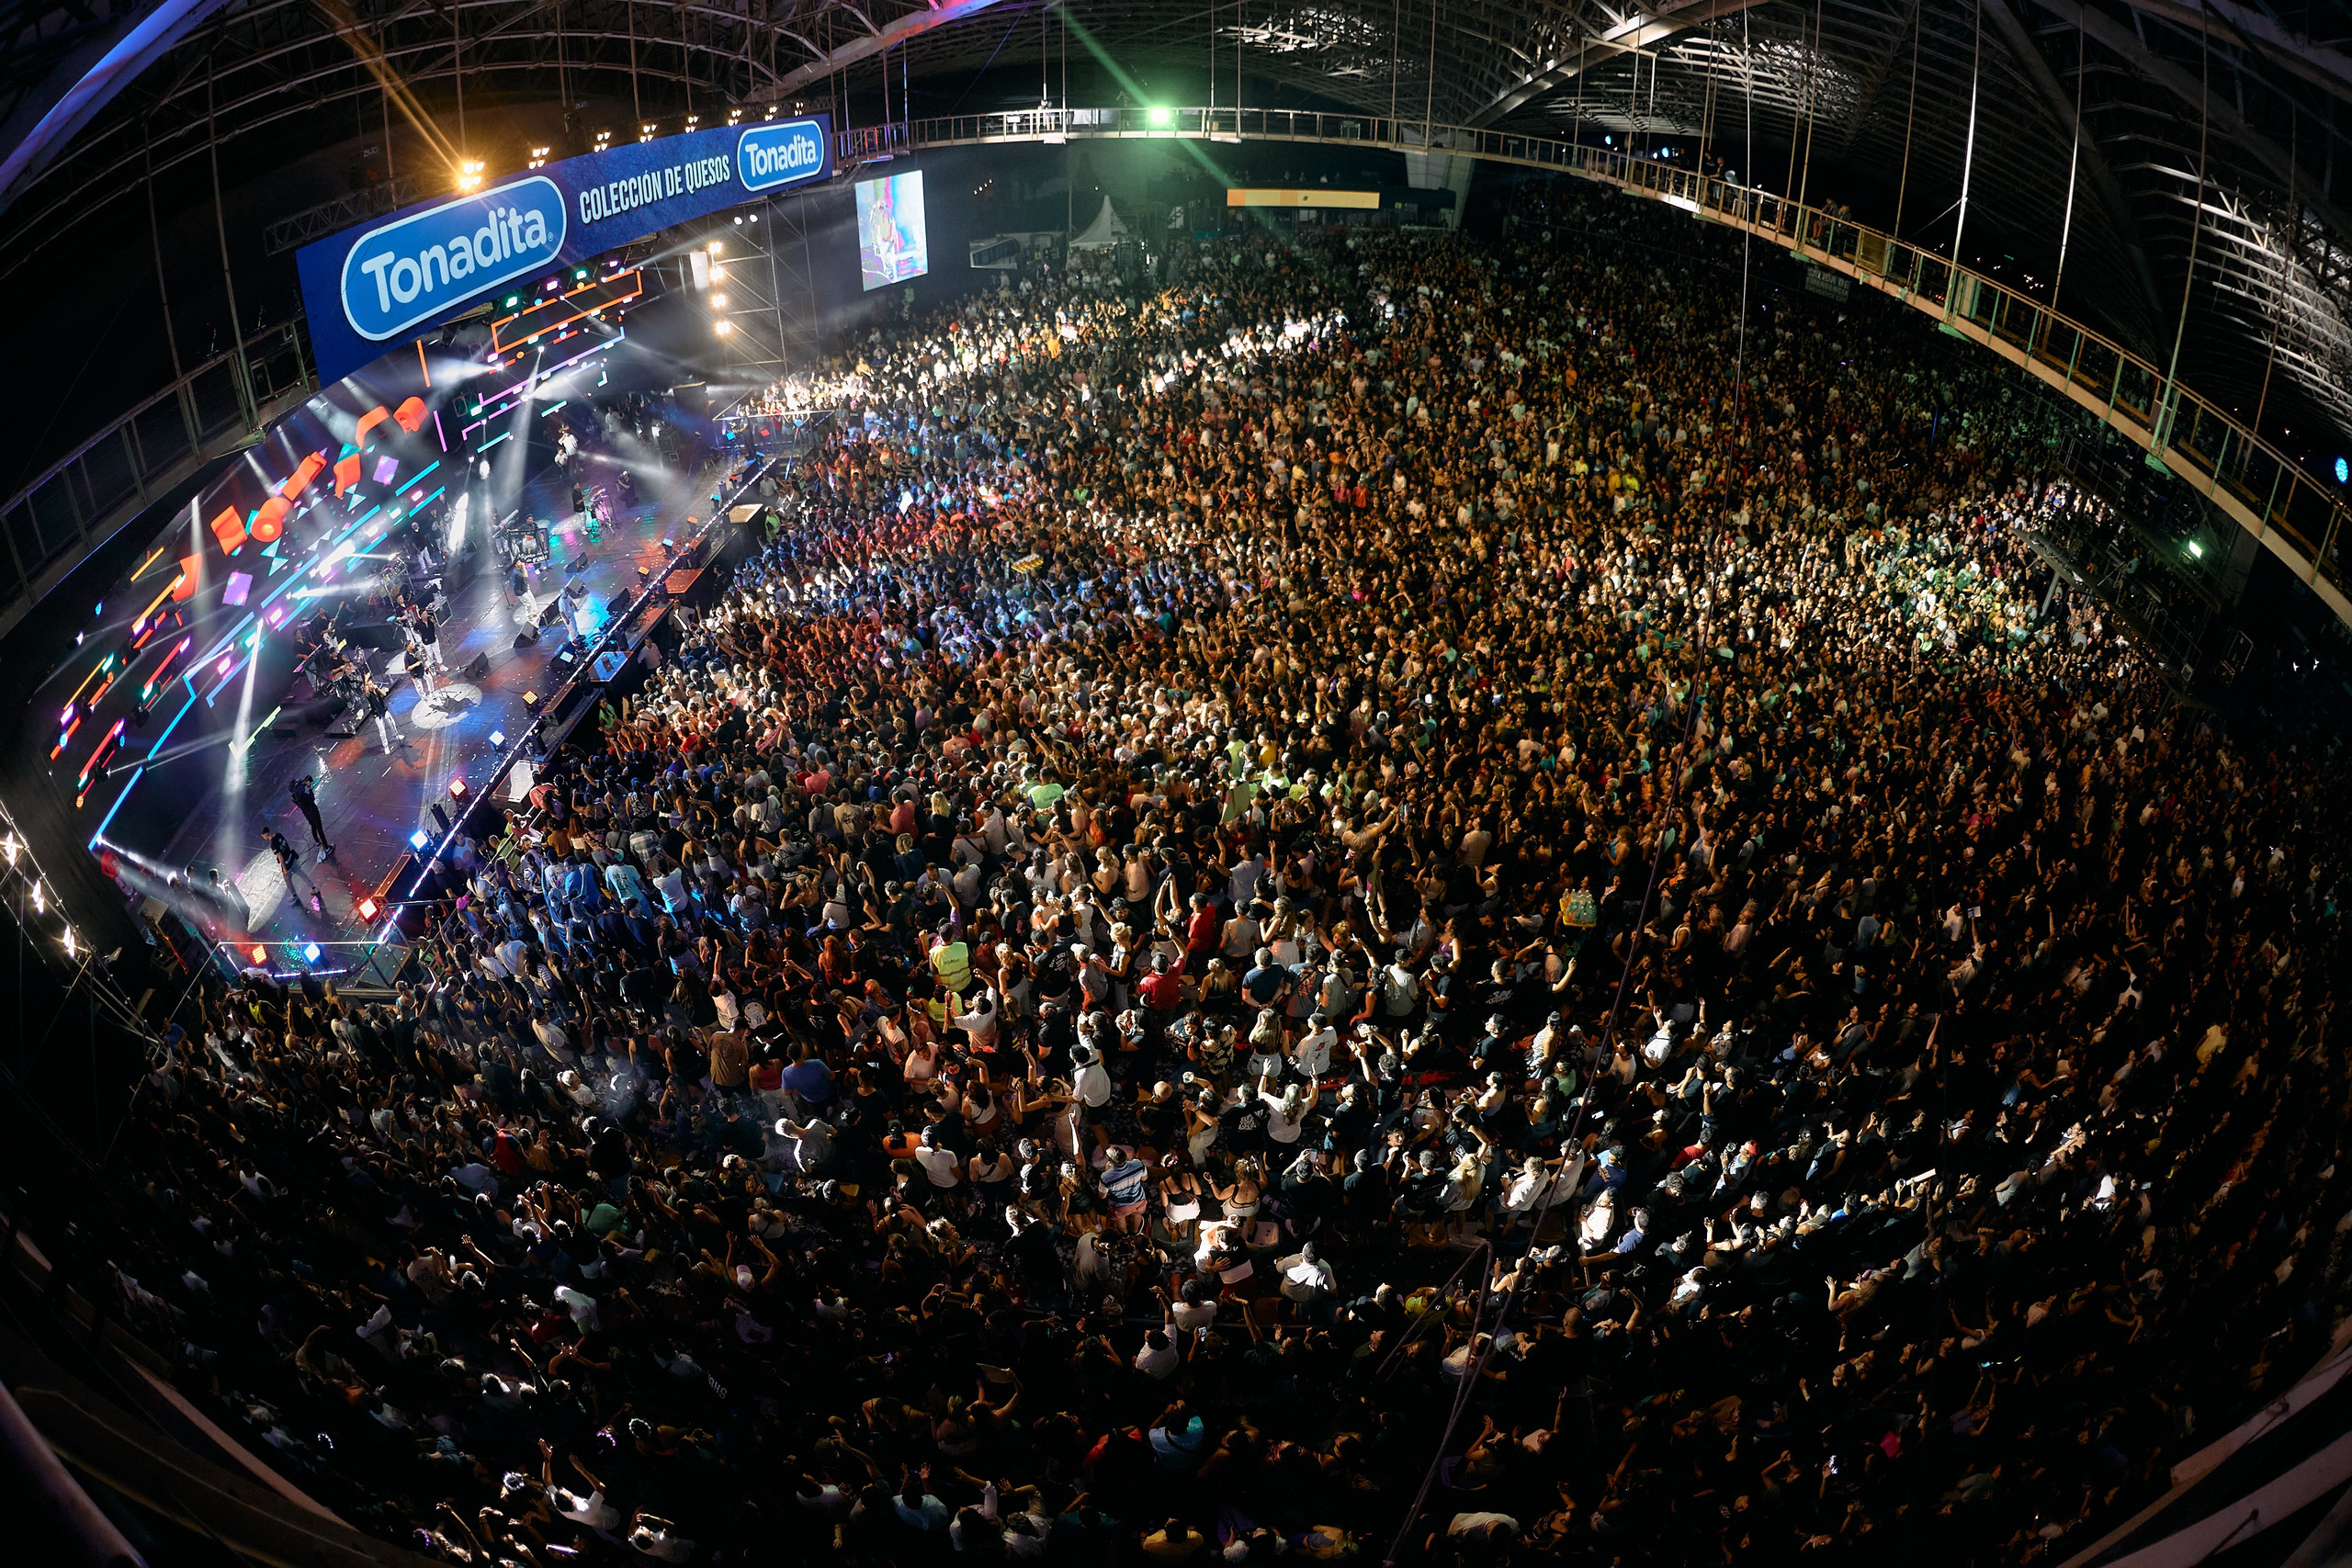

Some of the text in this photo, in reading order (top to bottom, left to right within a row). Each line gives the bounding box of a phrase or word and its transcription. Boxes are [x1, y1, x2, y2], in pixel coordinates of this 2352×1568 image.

[579, 154, 731, 225] COLECCIÓN DE QUESOS
[745, 134, 817, 177] Tonadita
[361, 207, 548, 313] Tonadita
